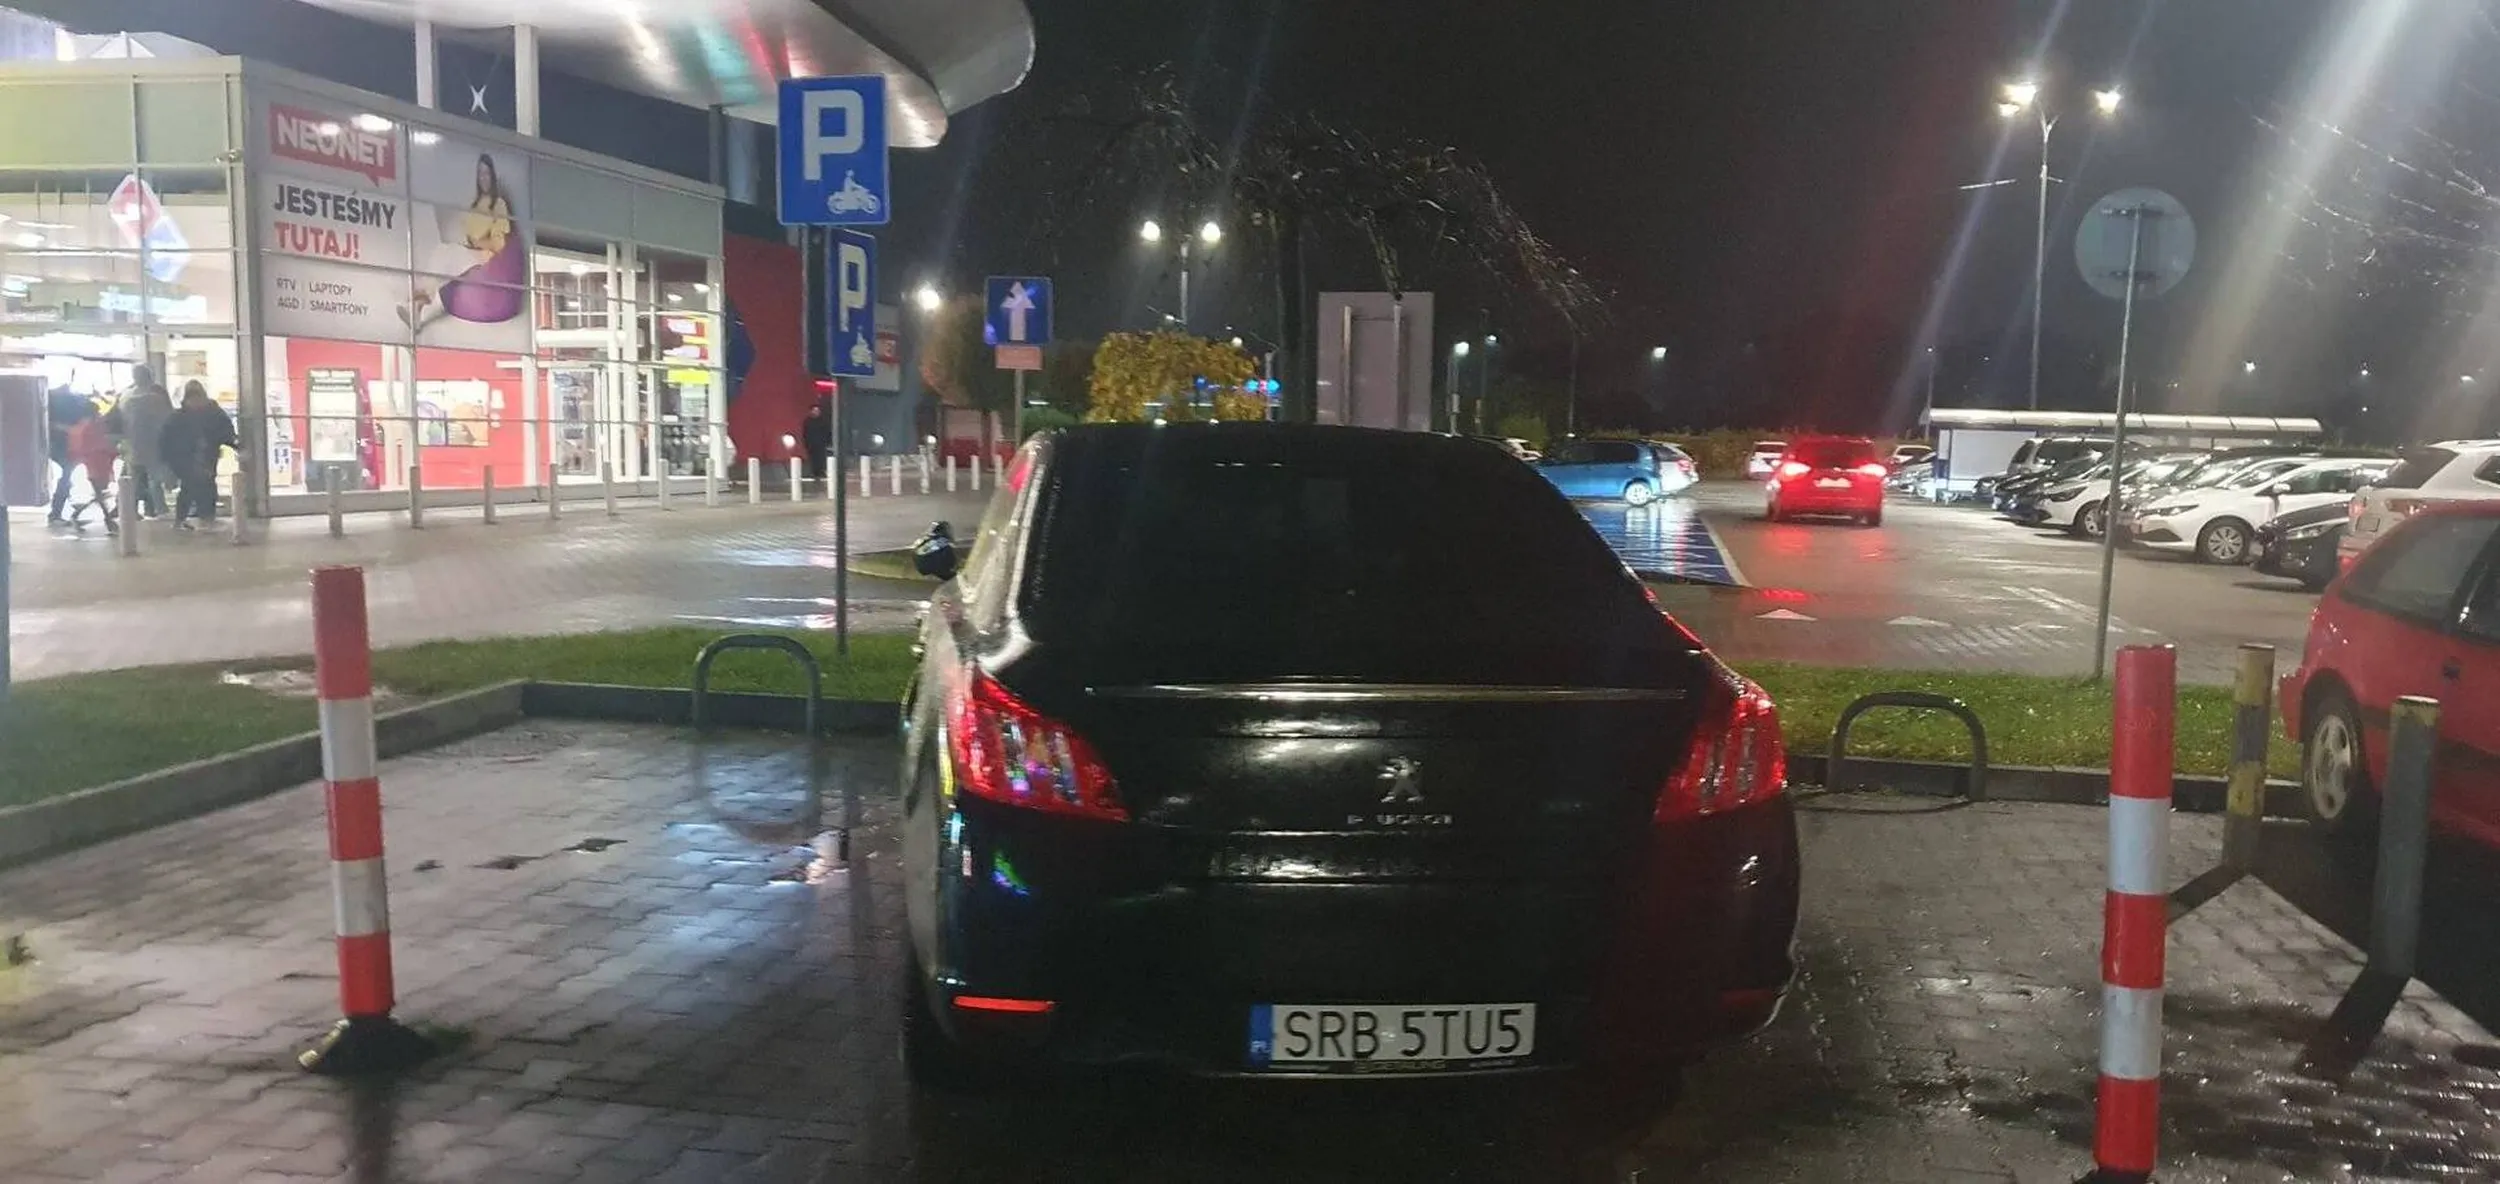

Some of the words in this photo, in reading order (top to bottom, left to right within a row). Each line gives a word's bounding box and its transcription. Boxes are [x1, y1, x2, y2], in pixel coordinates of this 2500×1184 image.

[277, 111, 389, 168] NEONET
[802, 90, 865, 181] P
[273, 183, 396, 230] JESTEŚMY
[273, 221, 360, 259] TUTAJ!
[276, 277, 297, 291] RTV
[309, 281, 353, 296] LAPTOPY
[277, 296, 300, 310] AGD
[310, 299, 369, 316] SMARTFONY
[838, 242, 868, 333] P
[1346, 814, 1453, 826] PUGEOT
[1284, 1010, 1380, 1059] SRB
[1400, 1008, 1522, 1057] 5TU5
